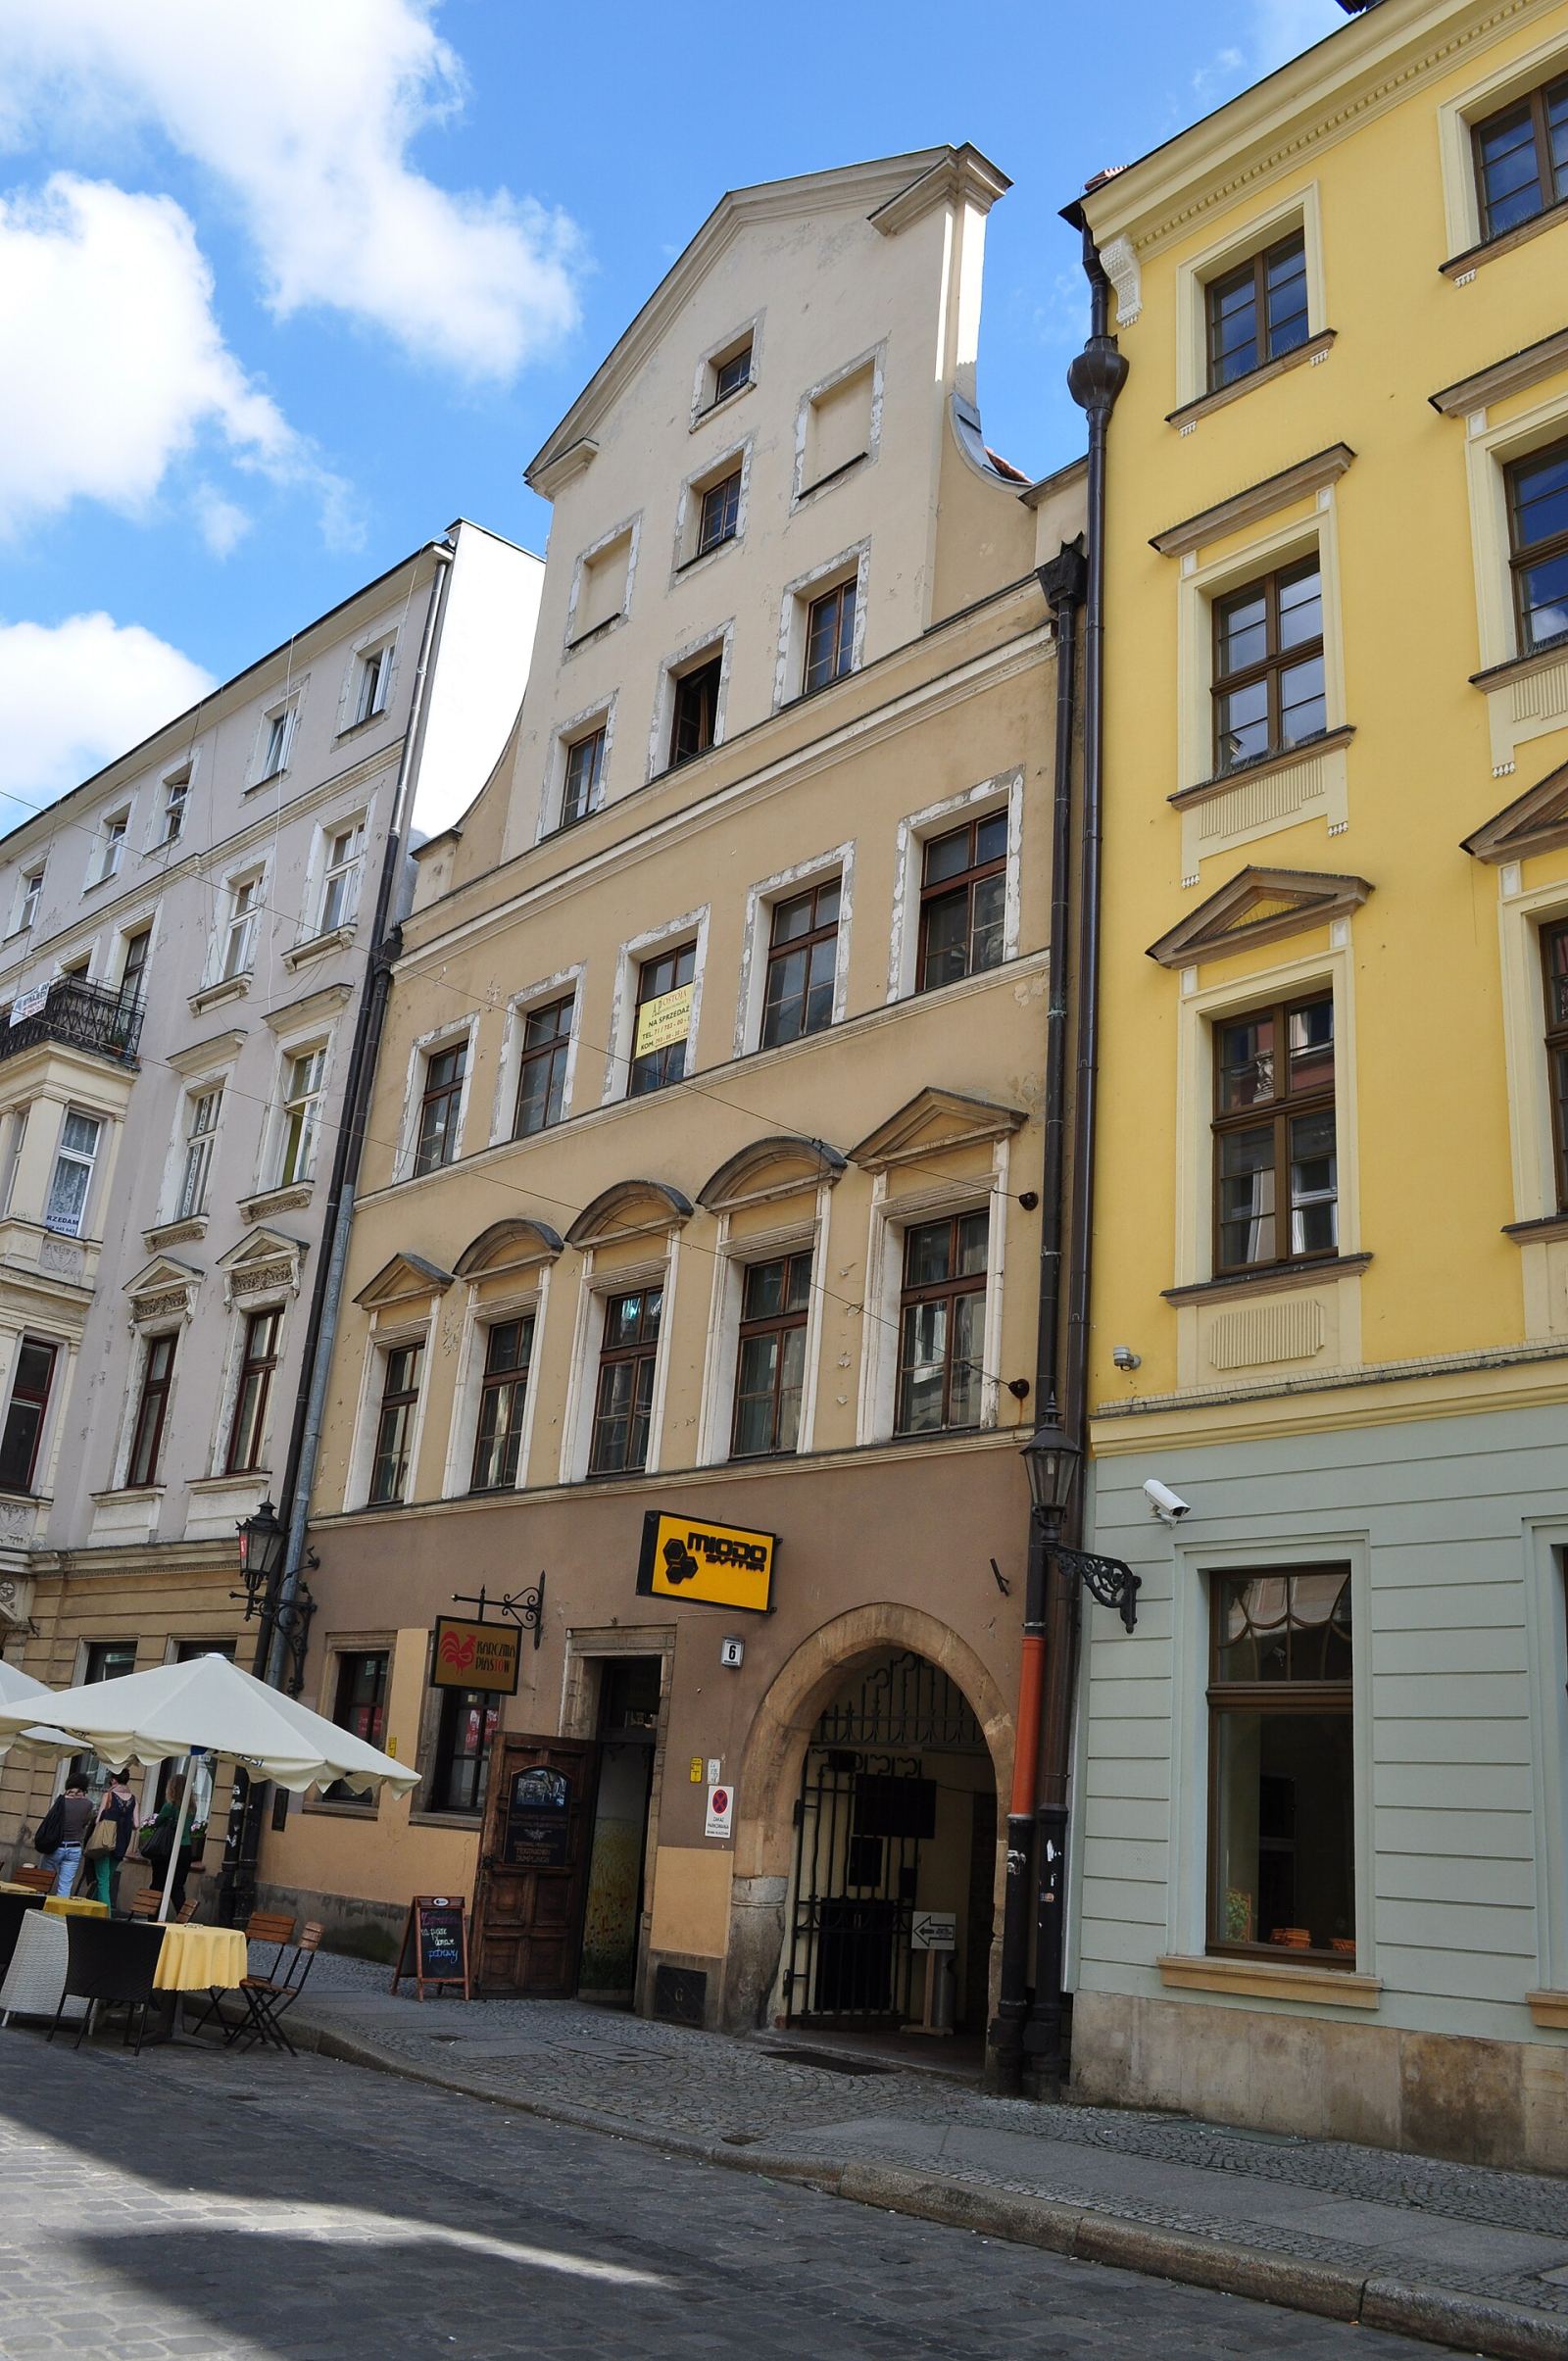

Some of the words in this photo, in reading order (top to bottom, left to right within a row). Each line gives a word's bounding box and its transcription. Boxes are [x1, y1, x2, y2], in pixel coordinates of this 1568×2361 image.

[687, 1532, 767, 1563] MIODO
[477, 1641, 515, 1657] KARCZMA
[729, 1645, 736, 1660] 6
